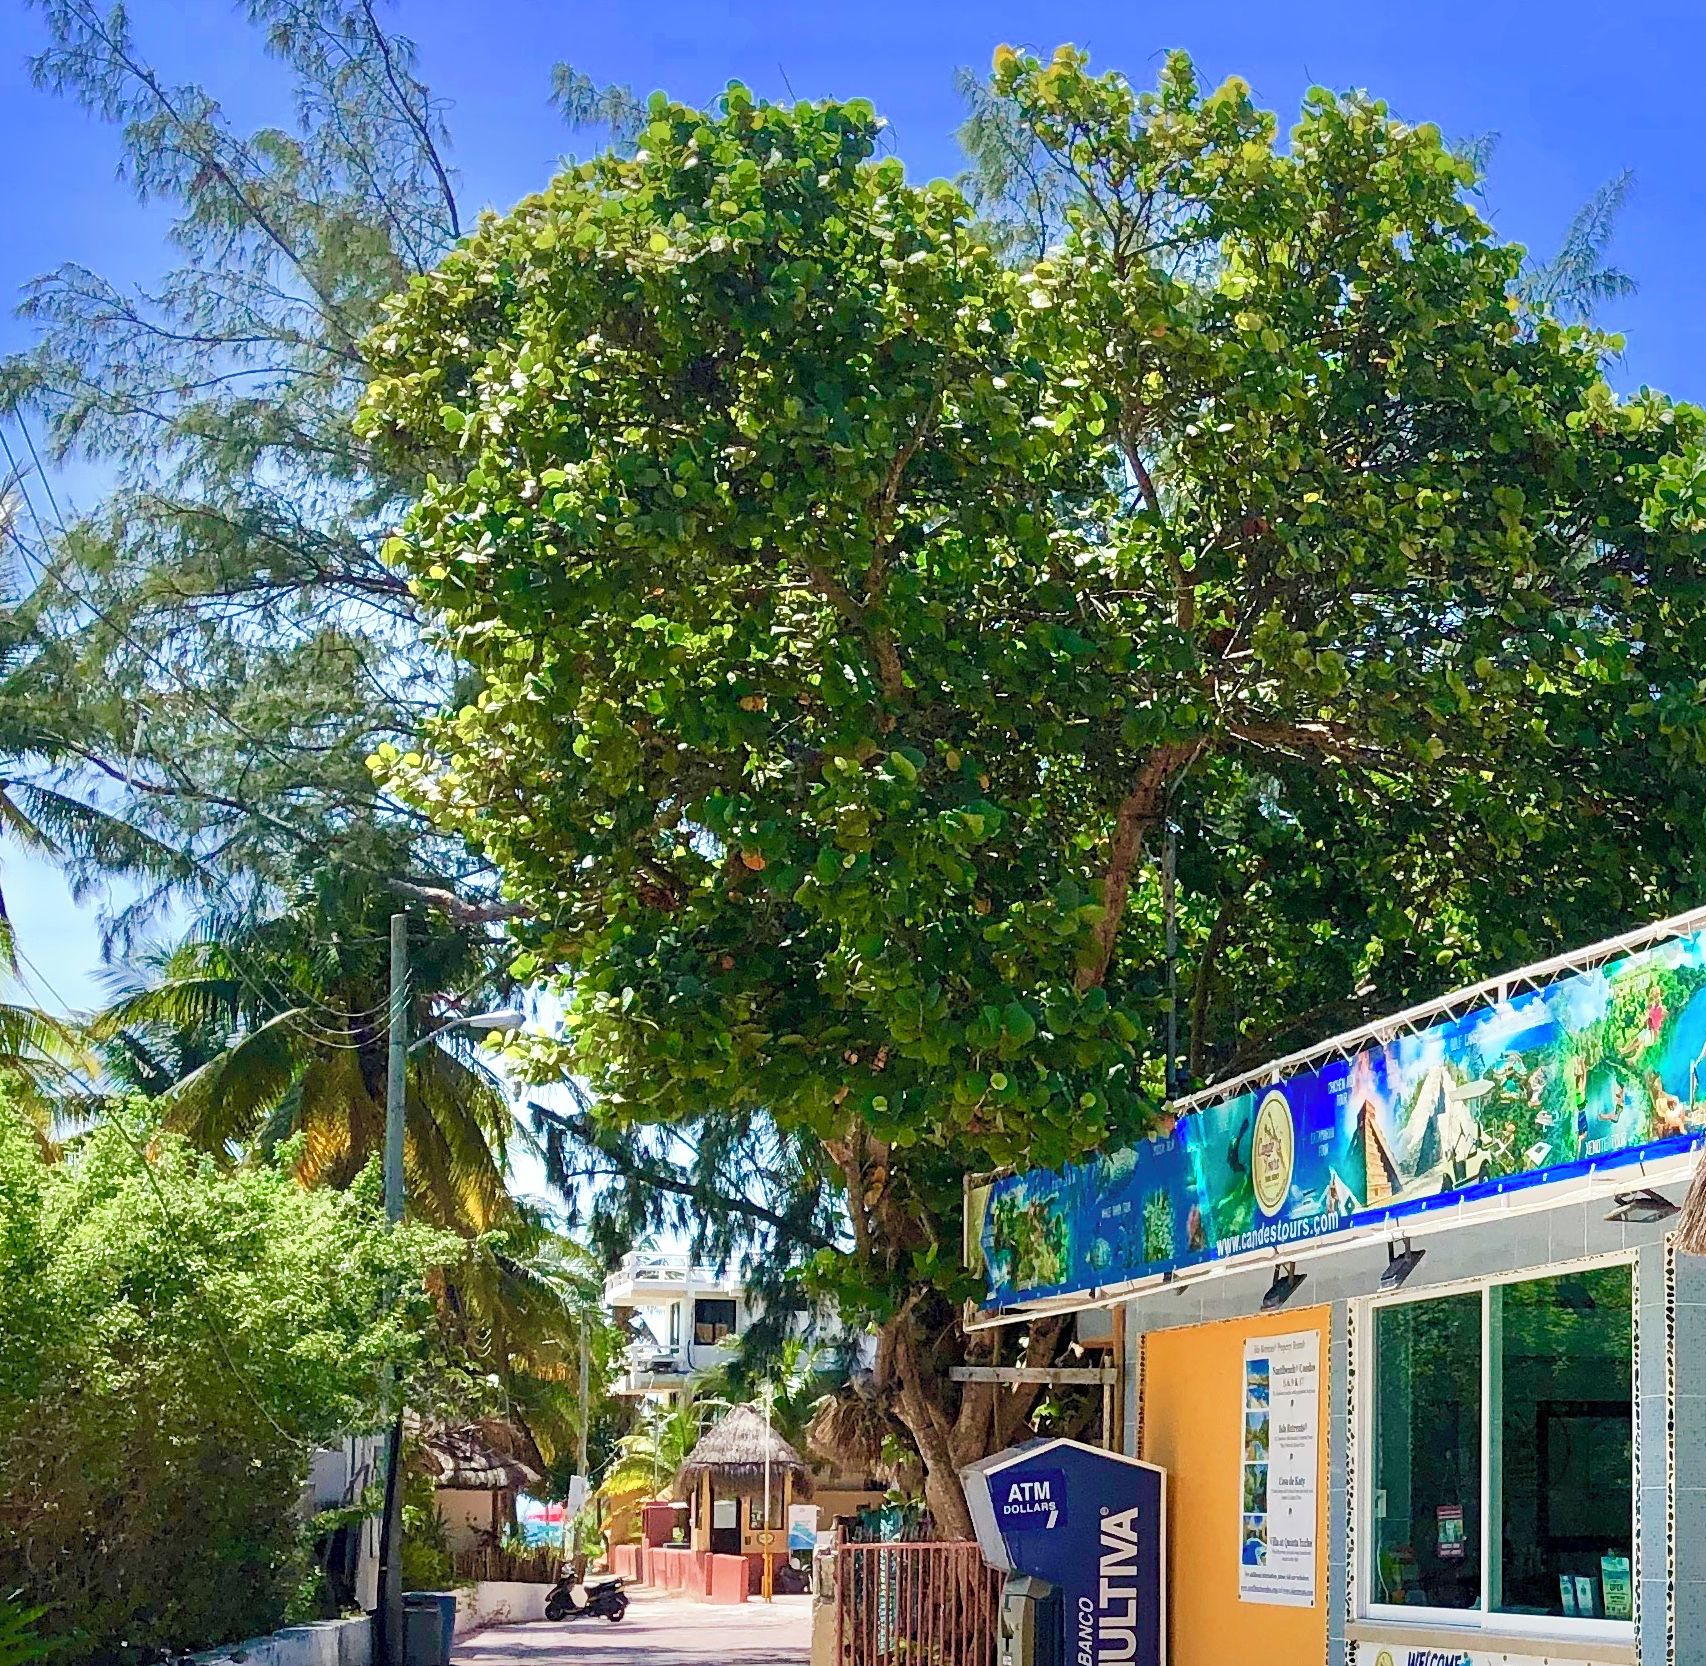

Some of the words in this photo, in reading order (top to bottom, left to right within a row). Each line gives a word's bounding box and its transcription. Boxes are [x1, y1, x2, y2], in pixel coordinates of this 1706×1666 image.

[1216, 1212, 1340, 1257] www.candestours.com
[1003, 1501, 1056, 1514] DOLLARS
[1008, 1480, 1050, 1502] ATM
[1098, 1507, 1139, 1666] ULTIVA
[1077, 1597, 1094, 1666] BANCO
